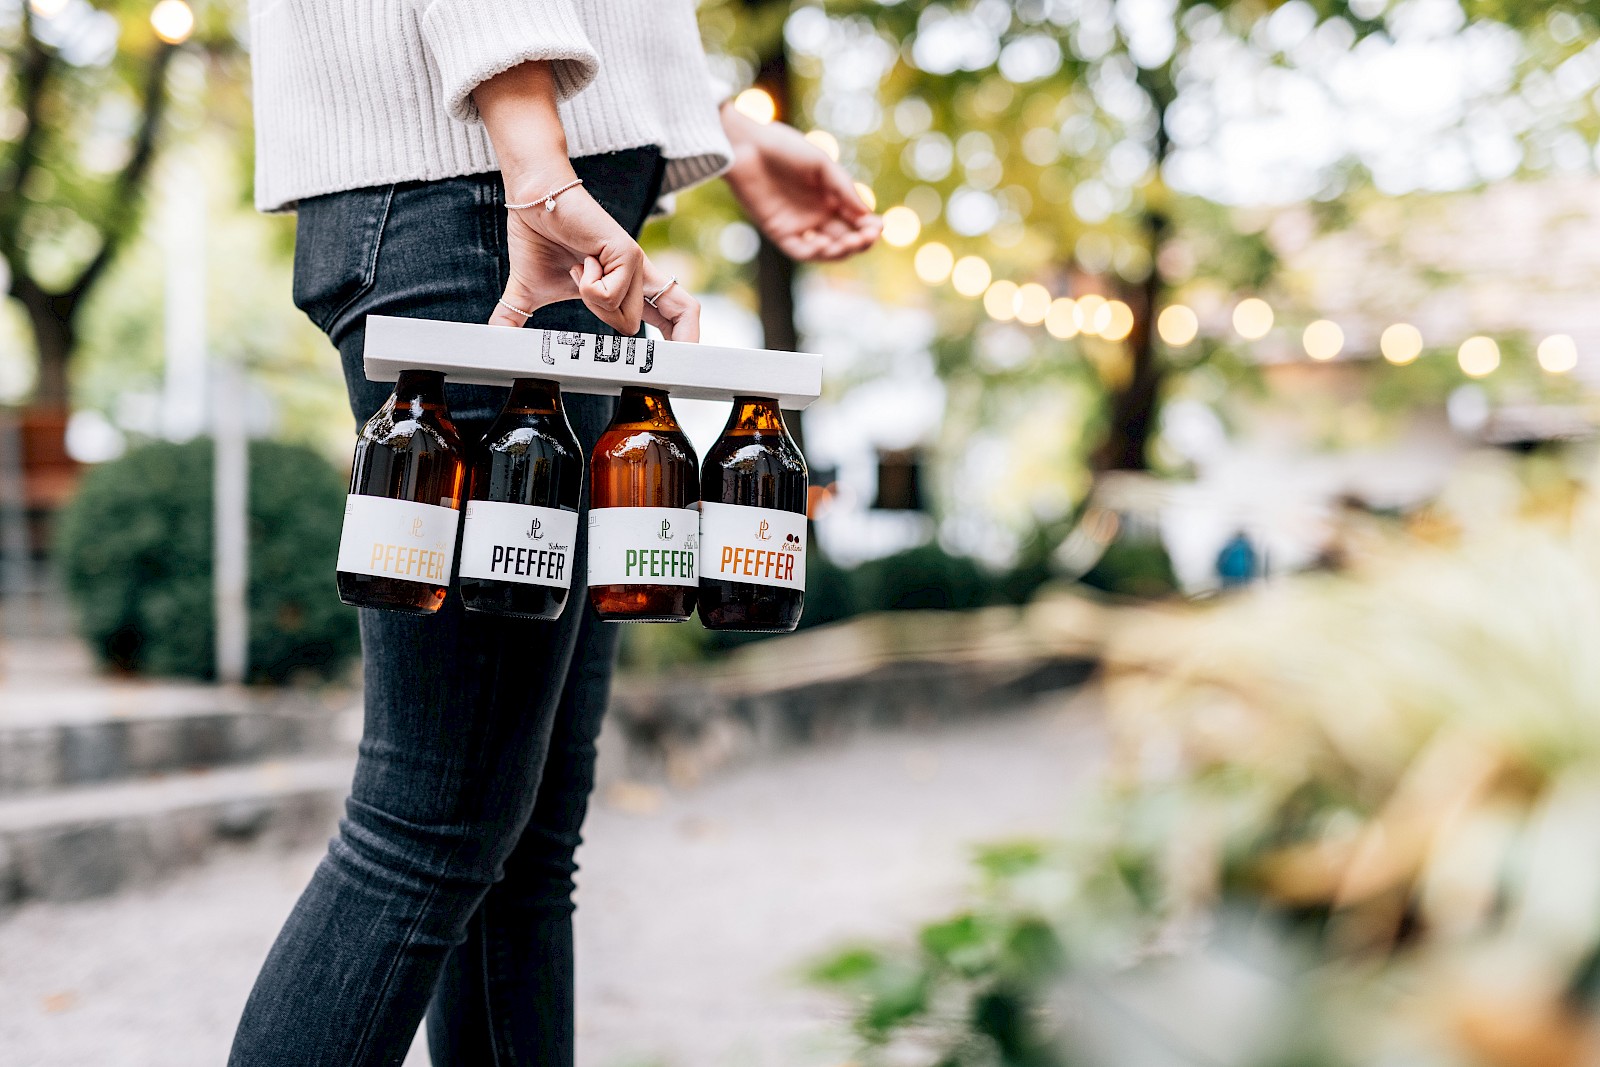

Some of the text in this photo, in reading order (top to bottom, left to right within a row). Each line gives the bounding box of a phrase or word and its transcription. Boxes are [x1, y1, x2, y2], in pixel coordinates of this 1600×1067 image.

[370, 543, 445, 580] PFEFFER
[491, 545, 565, 581] PFEFFER
[625, 549, 694, 579] PFEFFER
[720, 546, 794, 581] PFEFFER
